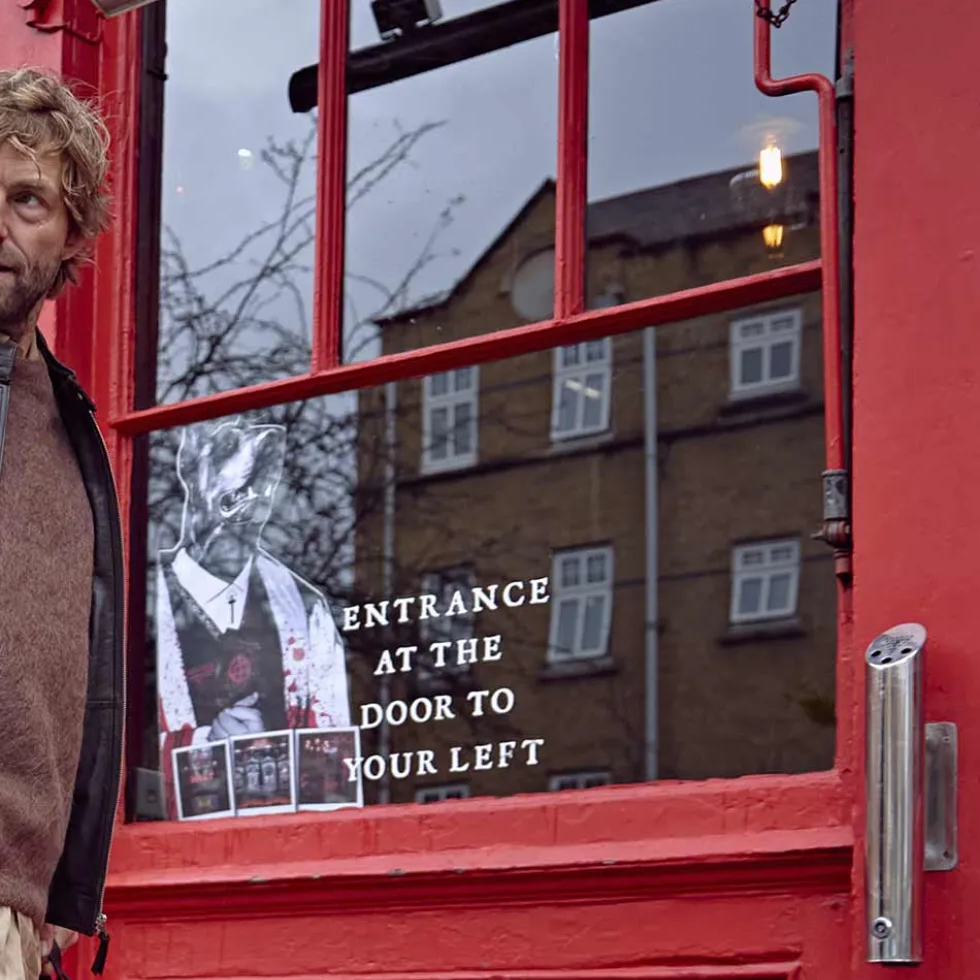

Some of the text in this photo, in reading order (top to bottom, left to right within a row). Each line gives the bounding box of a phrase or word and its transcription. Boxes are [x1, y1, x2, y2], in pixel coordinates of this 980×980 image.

[342, 577, 549, 631] ENTRANCE
[373, 634, 502, 676] AT THE
[359, 687, 515, 730] DOOR TO
[342, 738, 545, 783] YOUR LEFT
